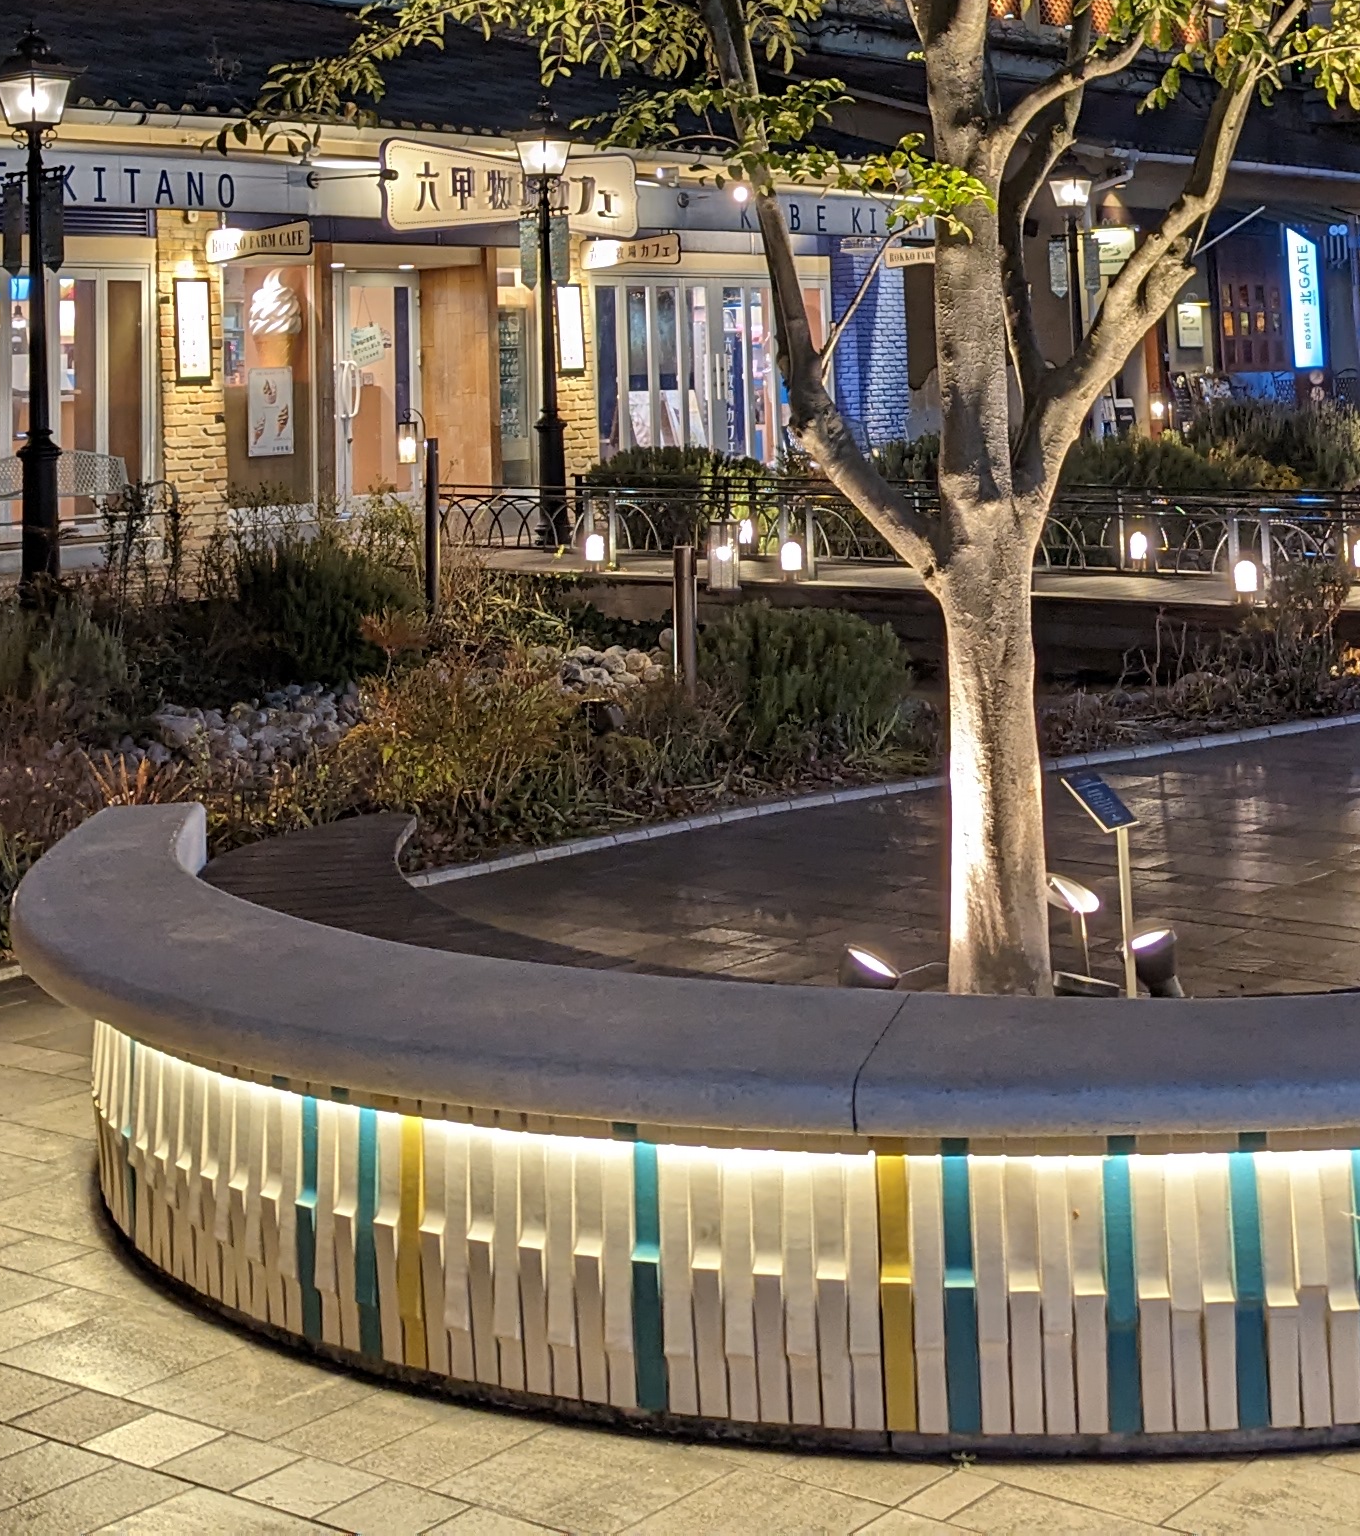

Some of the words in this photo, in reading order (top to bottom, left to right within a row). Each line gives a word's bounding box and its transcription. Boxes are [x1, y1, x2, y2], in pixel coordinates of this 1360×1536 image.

[741, 201, 827, 232] KBE
[249, 233, 276, 249] FARM
[279, 229, 304, 247] CAFE
